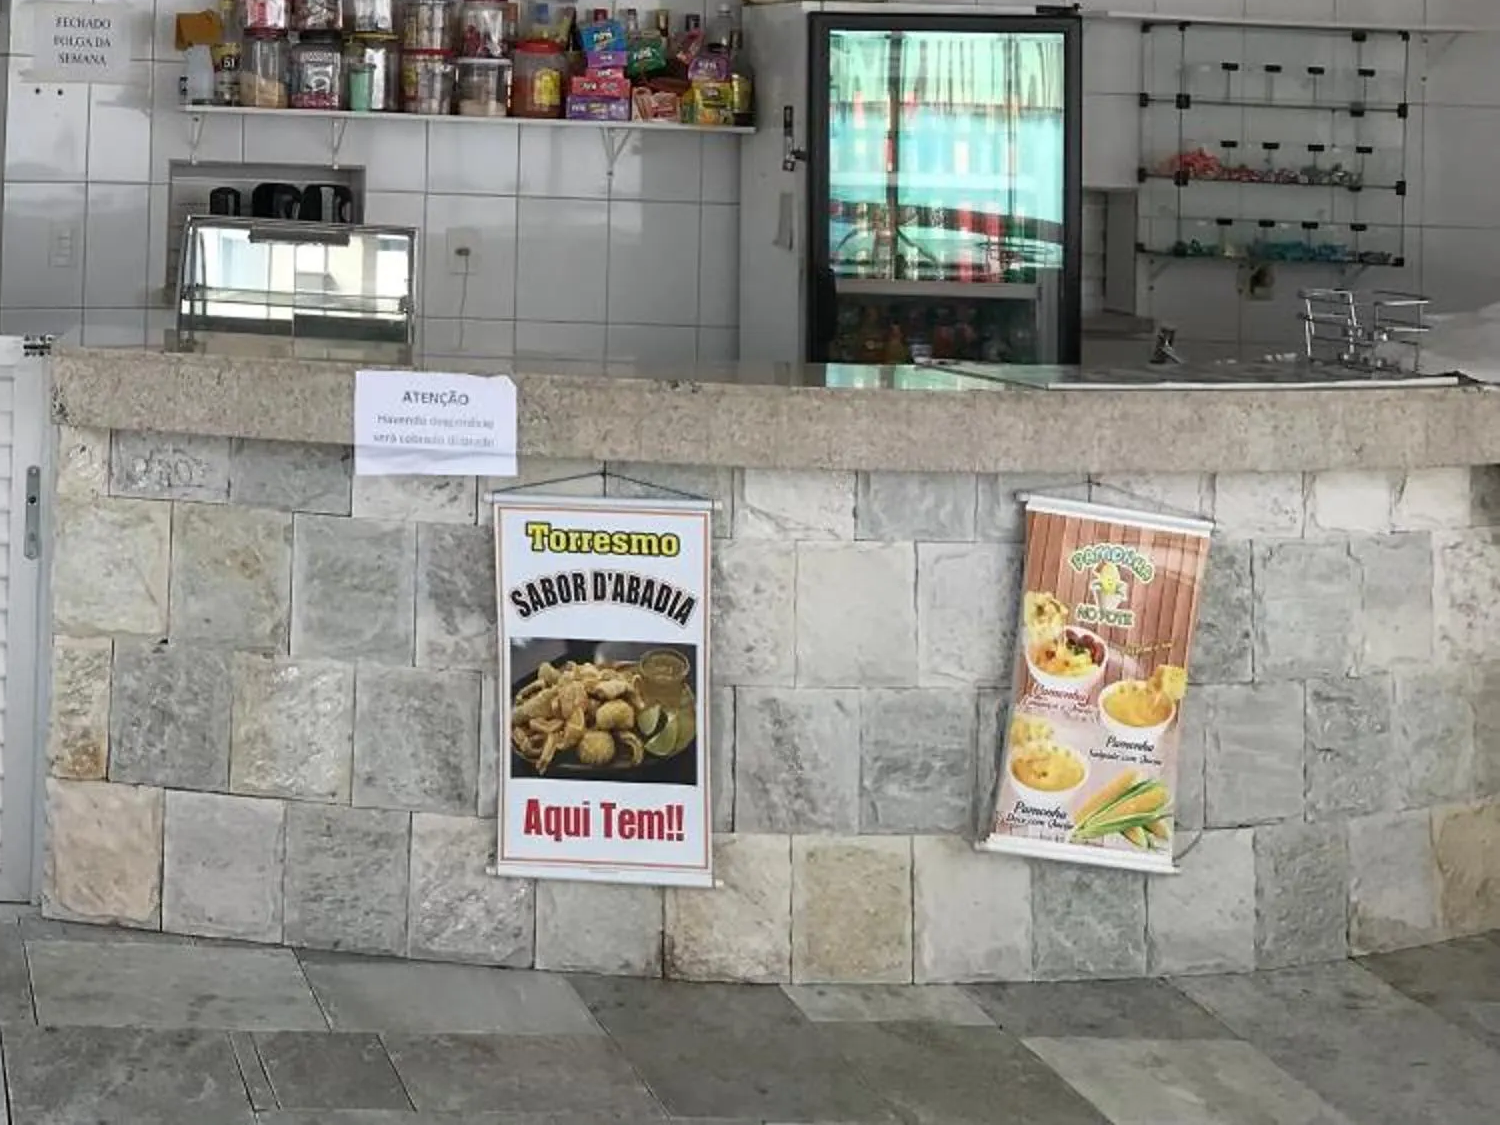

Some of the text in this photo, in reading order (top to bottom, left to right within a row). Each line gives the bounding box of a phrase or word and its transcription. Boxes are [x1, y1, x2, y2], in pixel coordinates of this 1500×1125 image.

[55, 16, 111, 29] FECHADO
[59, 52, 107, 66] SEMANA
[402, 390, 469, 407] ATENÇÃO
[526, 521, 680, 556] Torresmo
[511, 570, 696, 626] SABOR D'ABADIA
[1013, 800, 1067, 820] Pamonha
[524, 799, 684, 843] Aqui Tem!!
